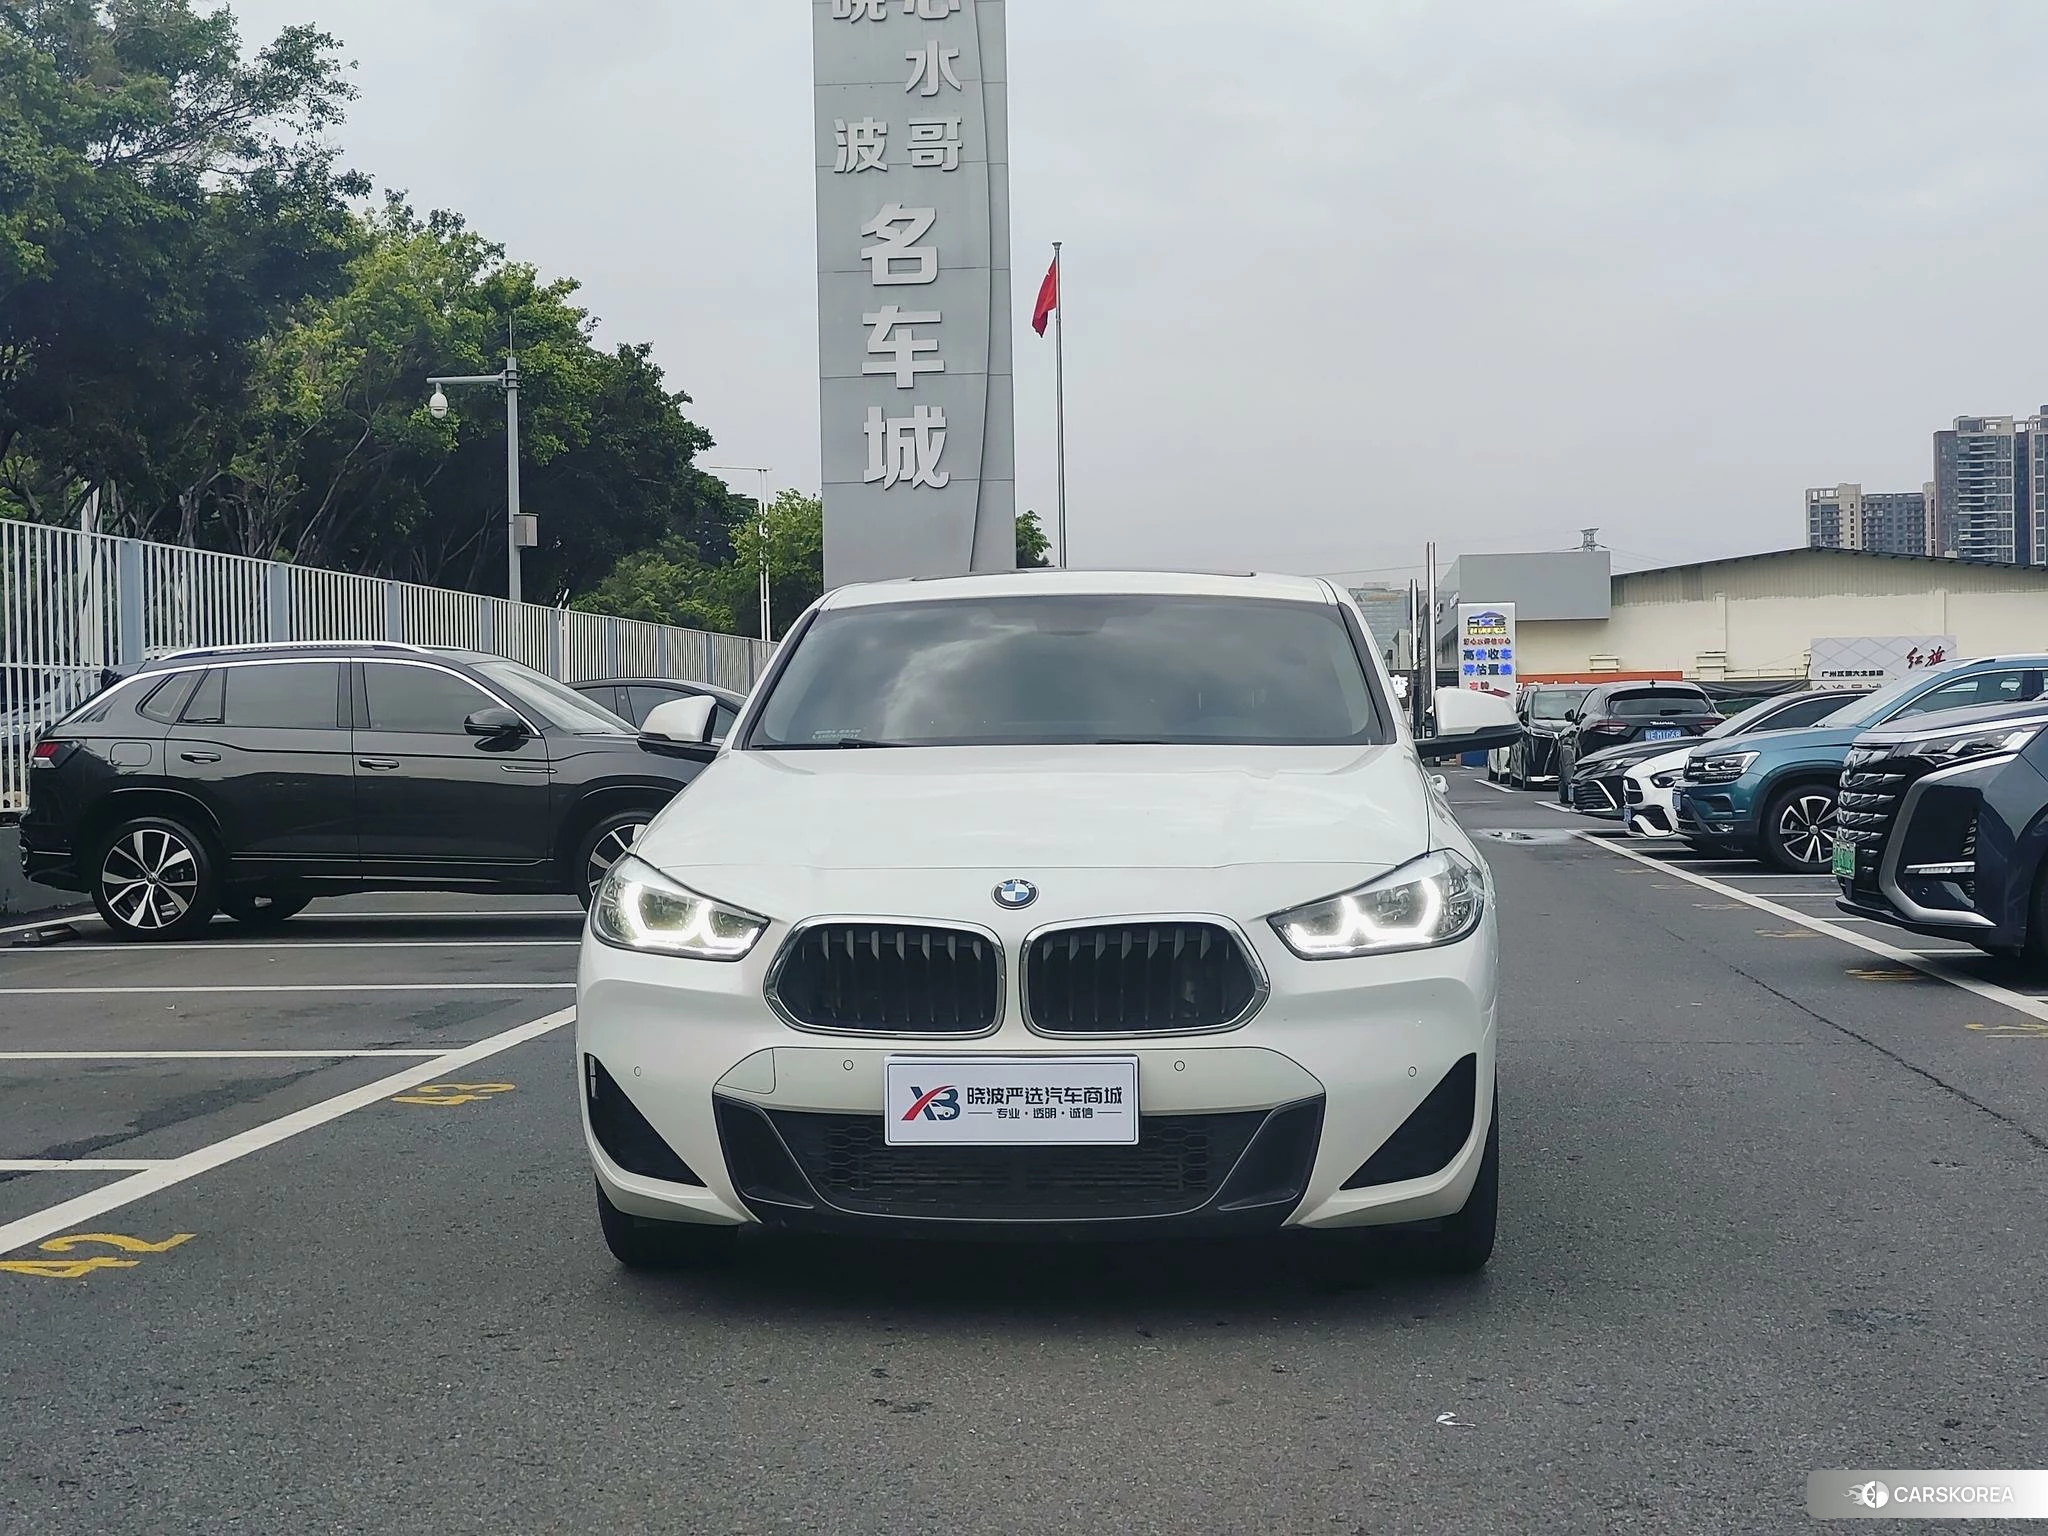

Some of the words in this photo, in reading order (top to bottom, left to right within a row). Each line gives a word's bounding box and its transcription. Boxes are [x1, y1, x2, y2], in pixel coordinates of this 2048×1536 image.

[861, 202, 950, 490] 名车城
[1906, 646, 1946, 669] 红旗
[967, 1086, 1123, 1105] 晓波严选汽车商城
